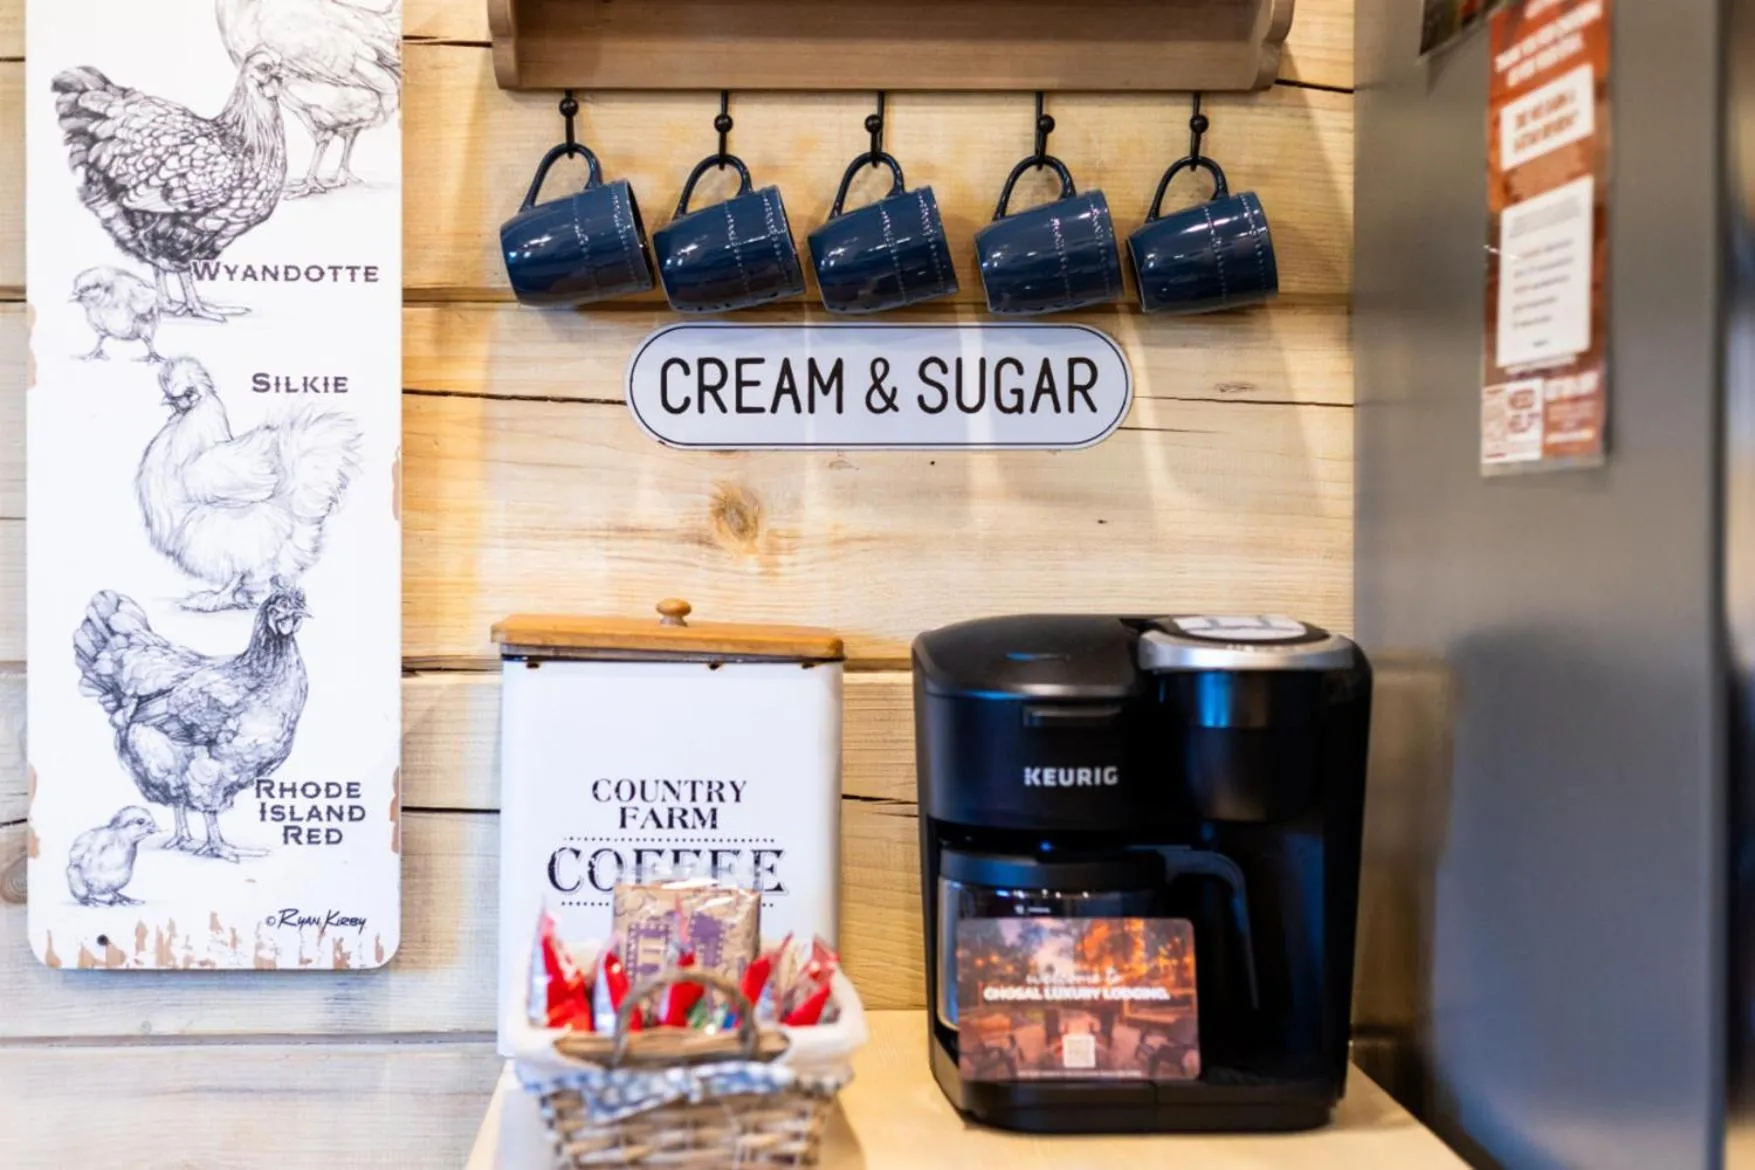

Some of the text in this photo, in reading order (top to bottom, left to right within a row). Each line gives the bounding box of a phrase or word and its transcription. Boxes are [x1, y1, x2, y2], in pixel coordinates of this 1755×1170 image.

[192, 261, 379, 282] WYANDOTTE
[251, 373, 348, 393] SILKIE
[660, 355, 1099, 415] CREAM & SUGAR
[1023, 766, 1118, 786] KEURIG
[255, 778, 361, 799] RHODE
[591, 778, 747, 803] COUNTRY
[259, 801, 366, 822] ISLAND
[618, 806, 718, 830] FARM
[282, 825, 343, 845] RED
